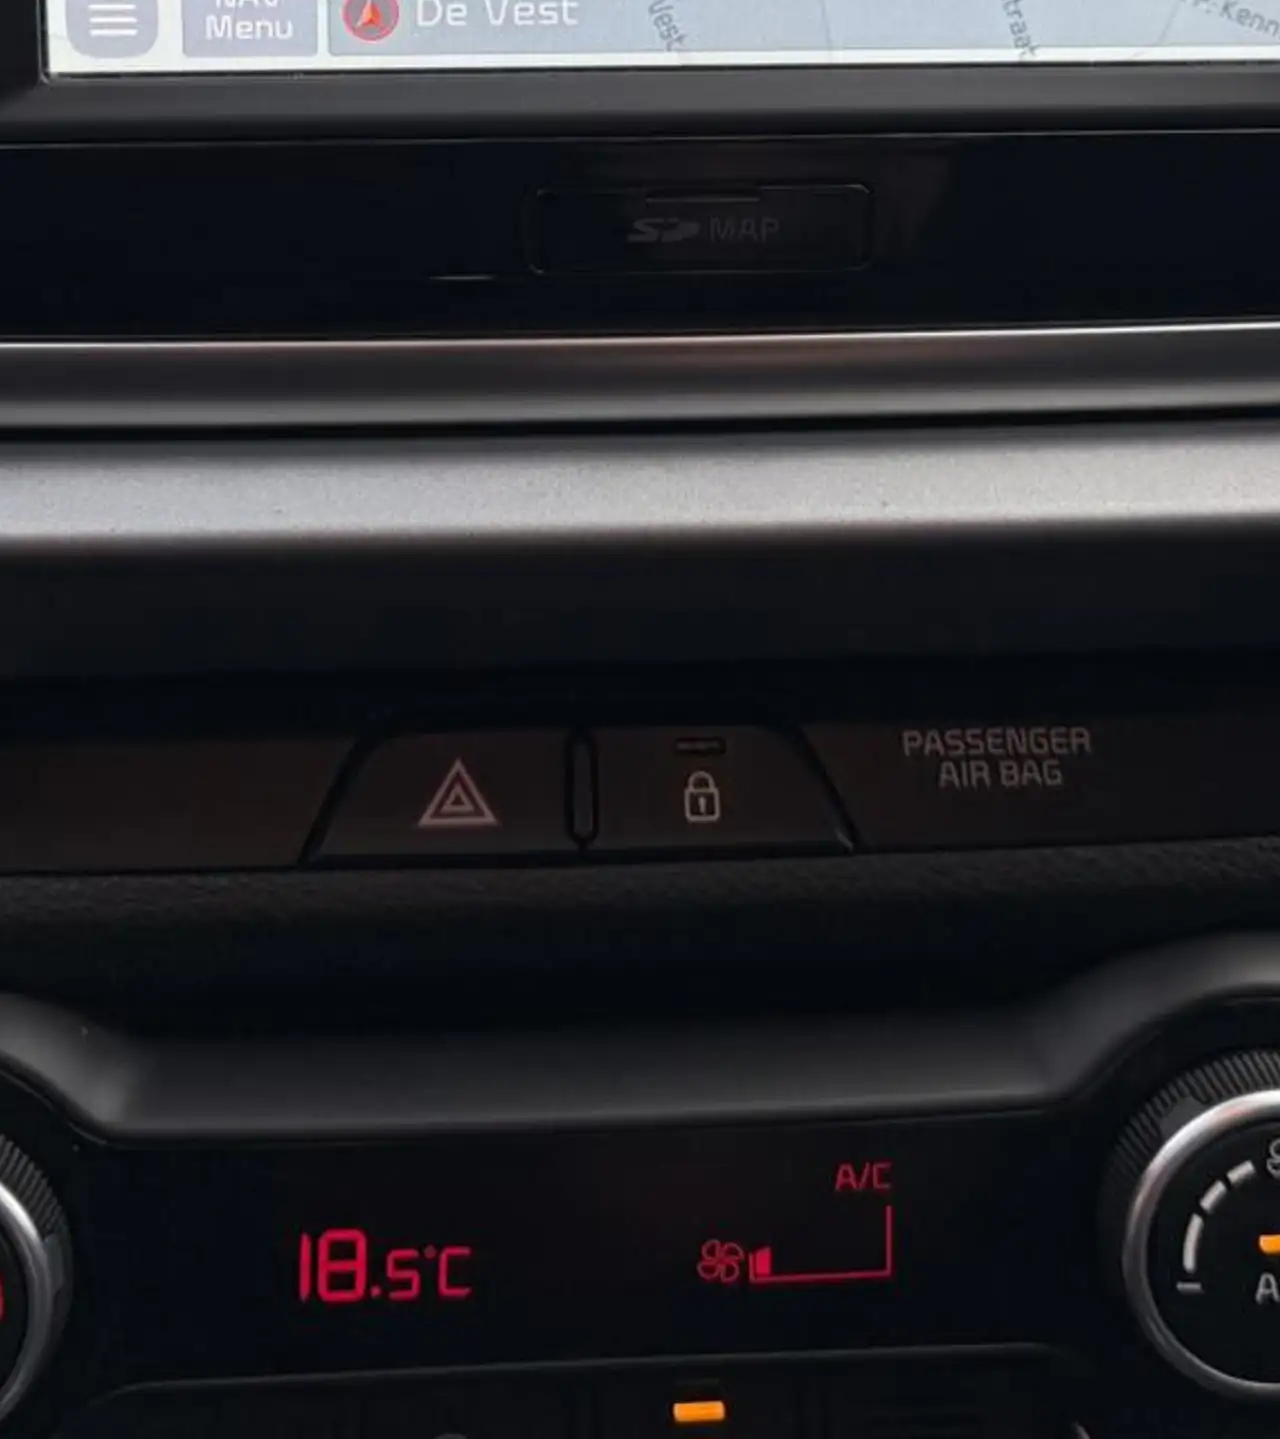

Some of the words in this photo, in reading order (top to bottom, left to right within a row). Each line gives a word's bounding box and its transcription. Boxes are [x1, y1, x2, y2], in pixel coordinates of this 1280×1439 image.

[205, 15, 294, 41] Menu
[708, 216, 780, 244] MAP
[902, 727, 1093, 757] PASSENGER
[939, 760, 993, 790] AIR
[999, 759, 1065, 788] BAG
[835, 1162, 893, 1192] A/C
